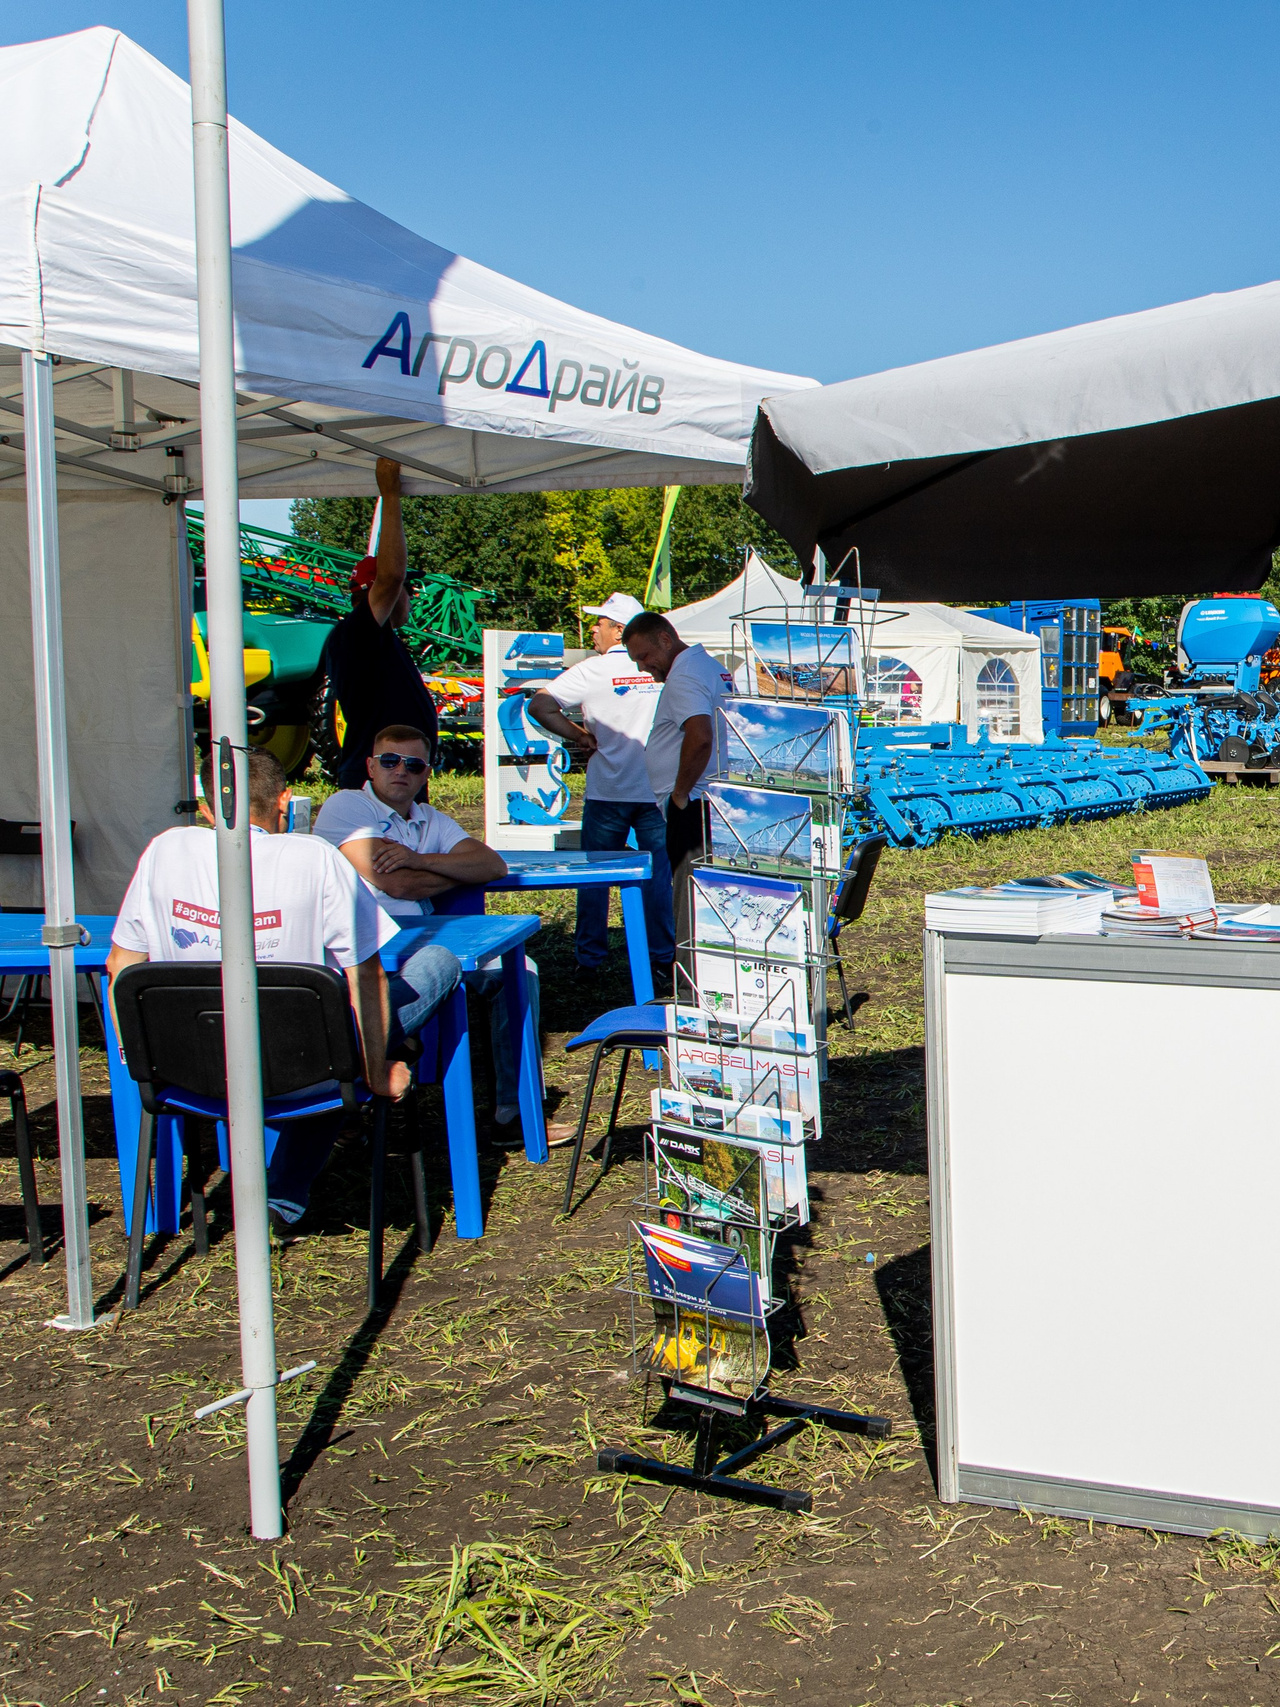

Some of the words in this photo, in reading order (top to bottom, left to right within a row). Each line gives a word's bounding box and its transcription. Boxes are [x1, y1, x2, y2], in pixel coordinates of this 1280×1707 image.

[361, 311, 665, 415] АгроДрайв
[614, 676, 655, 685] #agrodrivet
[754, 962, 788, 974] IRTEC
